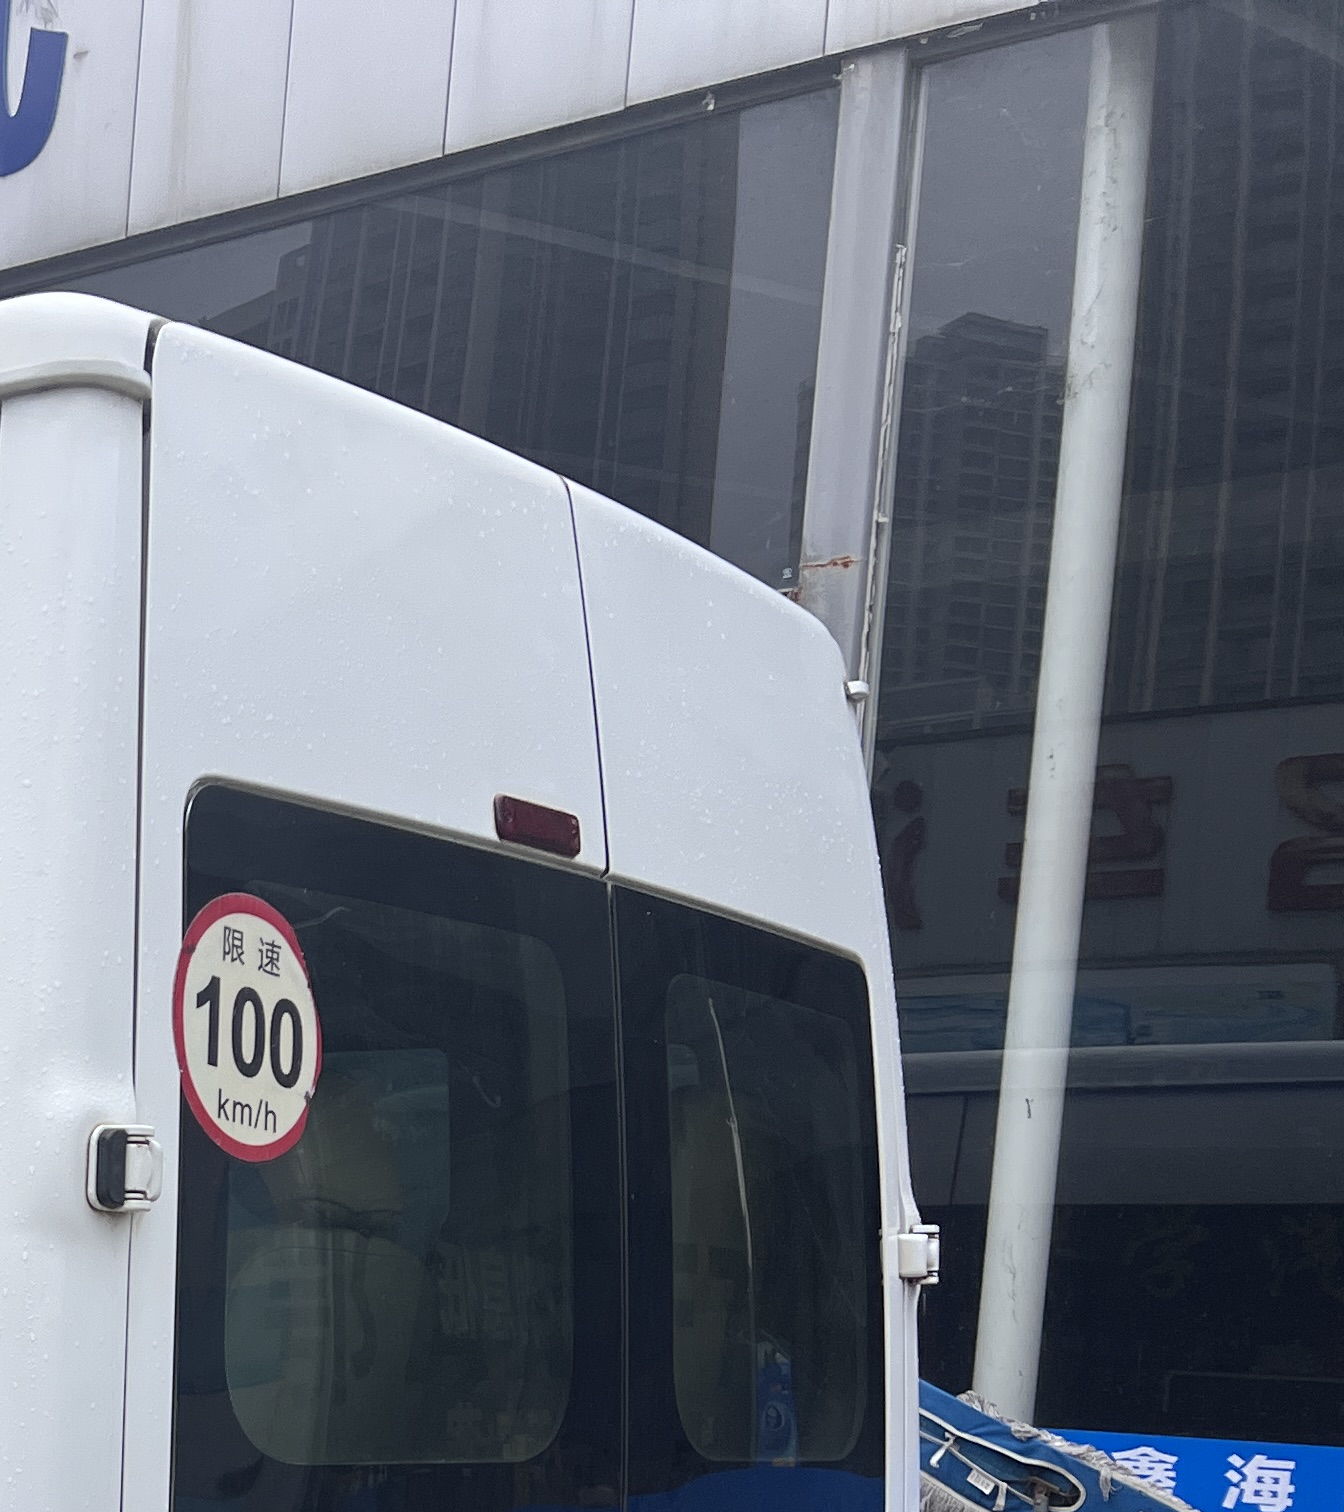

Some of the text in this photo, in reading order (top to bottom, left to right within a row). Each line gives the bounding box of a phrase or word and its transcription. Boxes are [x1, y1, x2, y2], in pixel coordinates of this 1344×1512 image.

[223, 925, 282, 977] 限速
[196, 975, 304, 1089] 100
[217, 1088, 277, 1133] km/h
